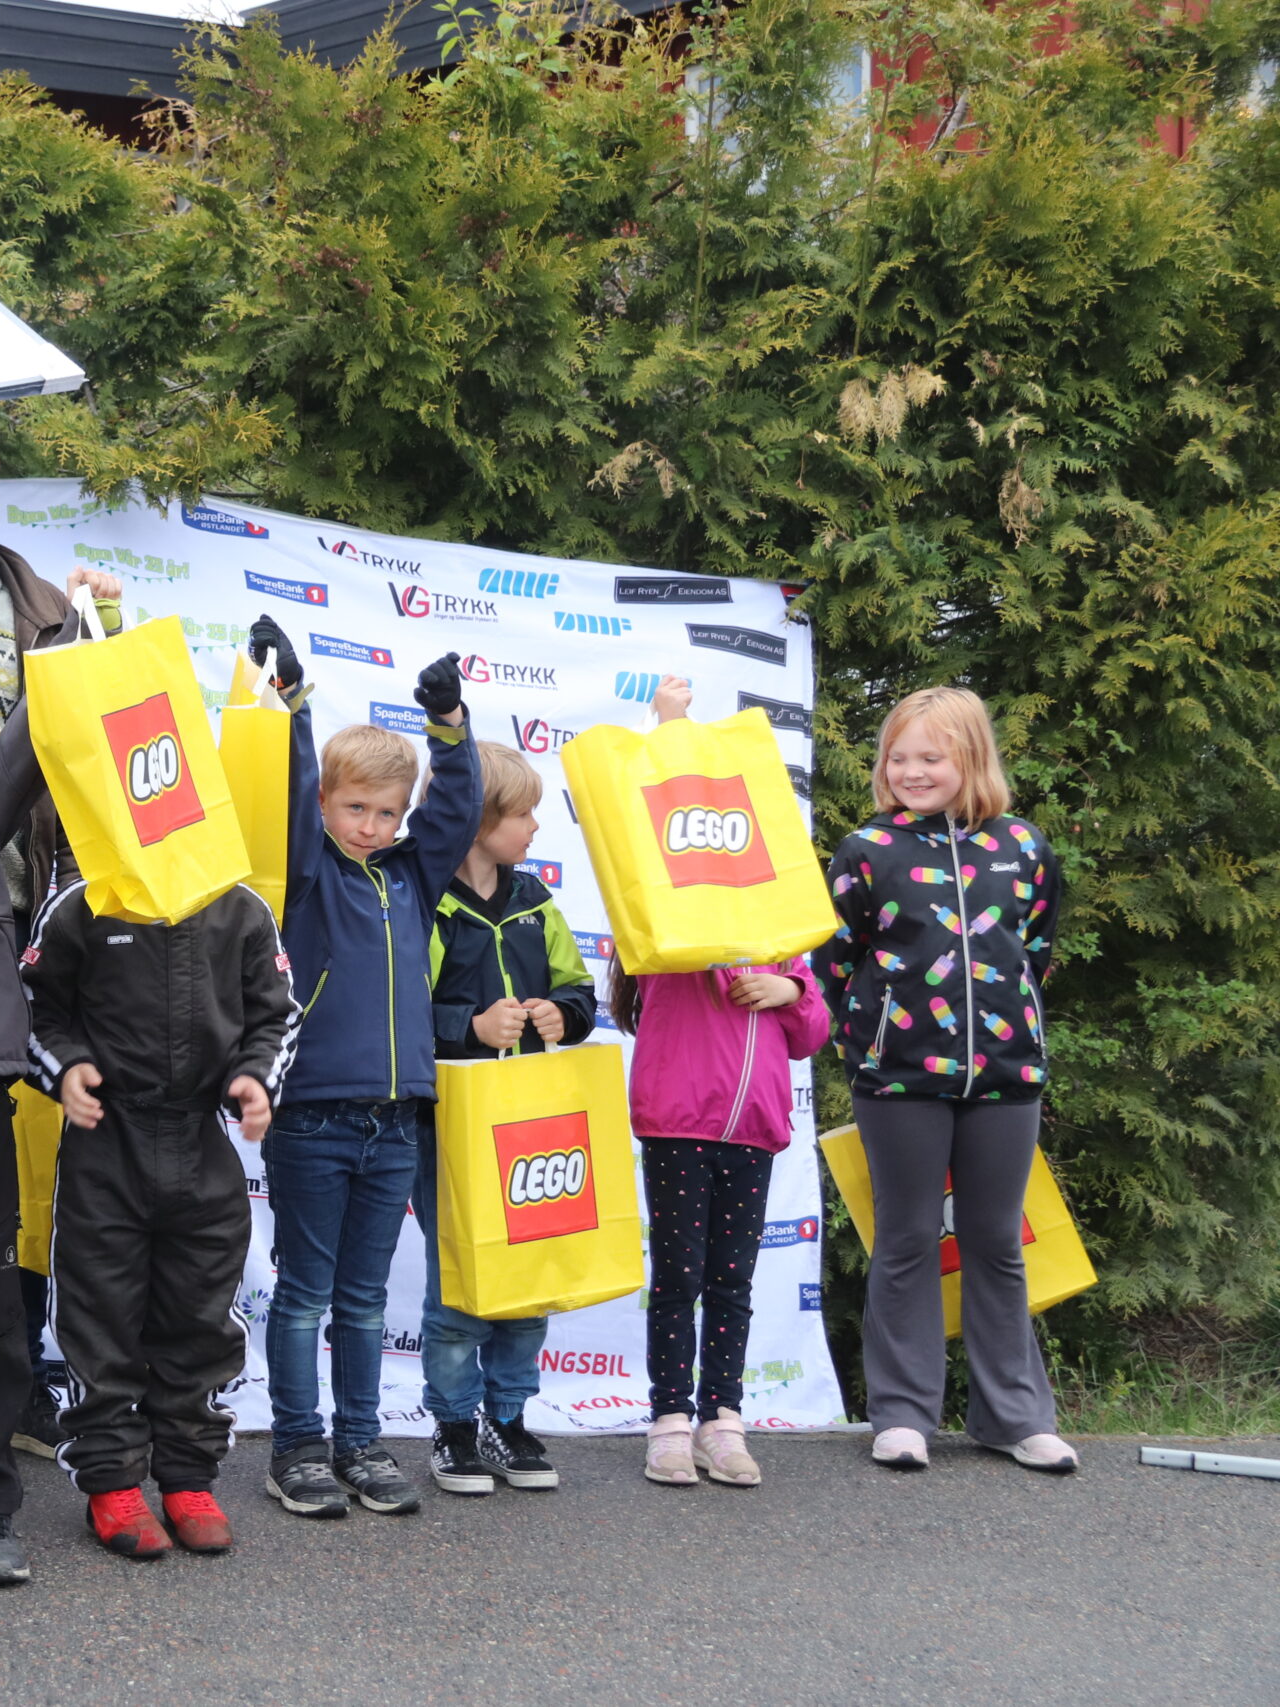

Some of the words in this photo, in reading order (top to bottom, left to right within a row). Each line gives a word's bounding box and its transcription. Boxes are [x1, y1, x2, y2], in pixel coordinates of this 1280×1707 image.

[201, 522, 246, 533] ØSTLANDET
[74, 543, 113, 563] Byen
[113, 547, 142, 568] Vår
[144, 555, 163, 573] 25
[166, 559, 190, 580] år!
[359, 551, 422, 577] TRYKK
[249, 574, 305, 594] SpareBank
[311, 590, 319, 600] 1
[637, 587, 659, 596] RYEN
[715, 587, 727, 596] AS
[431, 593, 497, 616] TRYKK
[206, 623, 227, 641] 25
[314, 636, 370, 655] SpareBank
[376, 653, 384, 662] 1
[773, 646, 784, 656] AS
[490, 663, 556, 685] TRYKK
[130, 734, 179, 802] LO
[667, 808, 749, 853] LEGO
[545, 867, 554, 880] 1
[508, 1148, 586, 1206] LEGO
[803, 1222, 811, 1235] 1
[535, 1349, 631, 1378] NGSBIL
